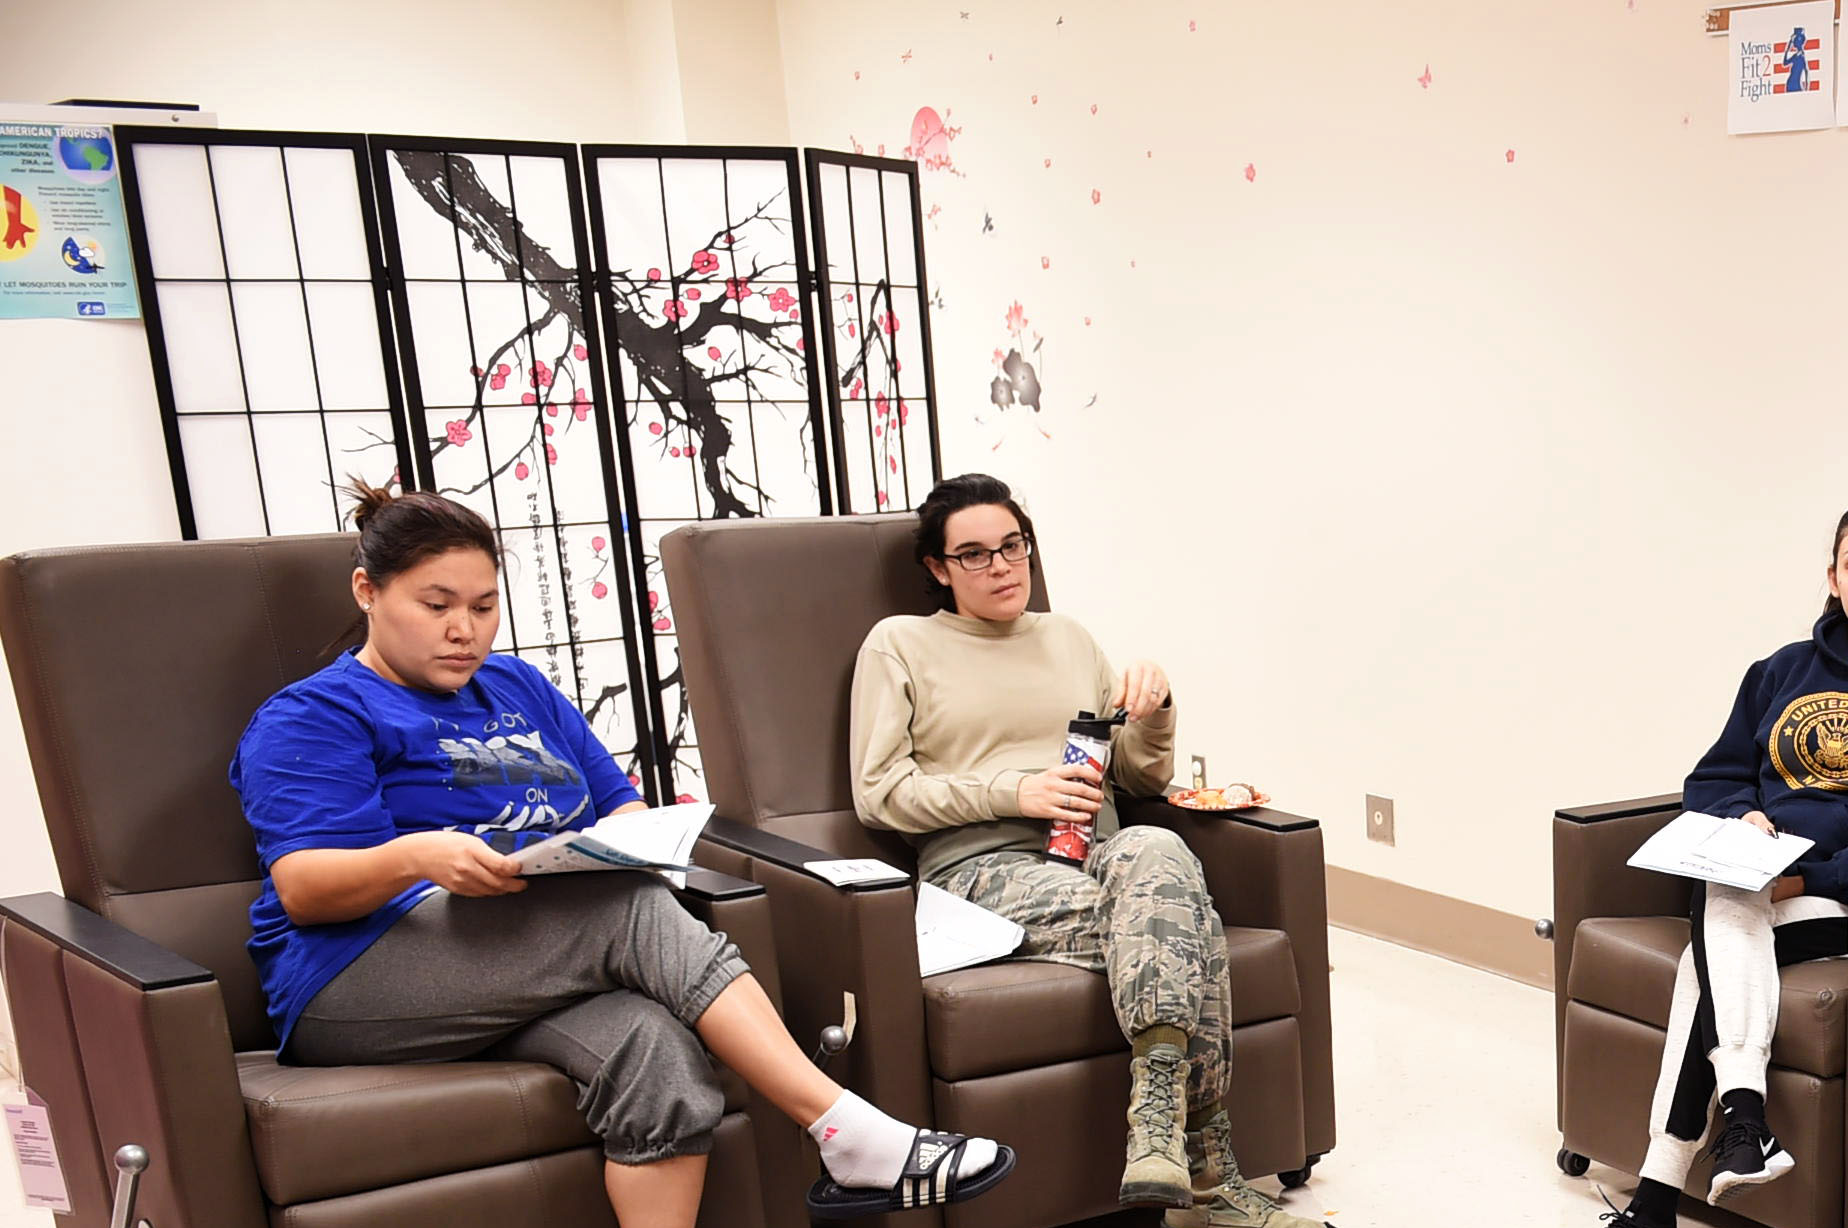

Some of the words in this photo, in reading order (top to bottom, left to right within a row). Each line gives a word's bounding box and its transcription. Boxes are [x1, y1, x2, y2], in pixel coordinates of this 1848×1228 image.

[1740, 41, 1772, 55] Moms
[1740, 79, 1773, 103] Fight
[0, 126, 52, 137] AMERICAN
[55, 127, 103, 139] TROPICS?
[19, 281, 67, 289] MOSQUITOES
[483, 712, 528, 733] GOT
[525, 787, 549, 803] ON
